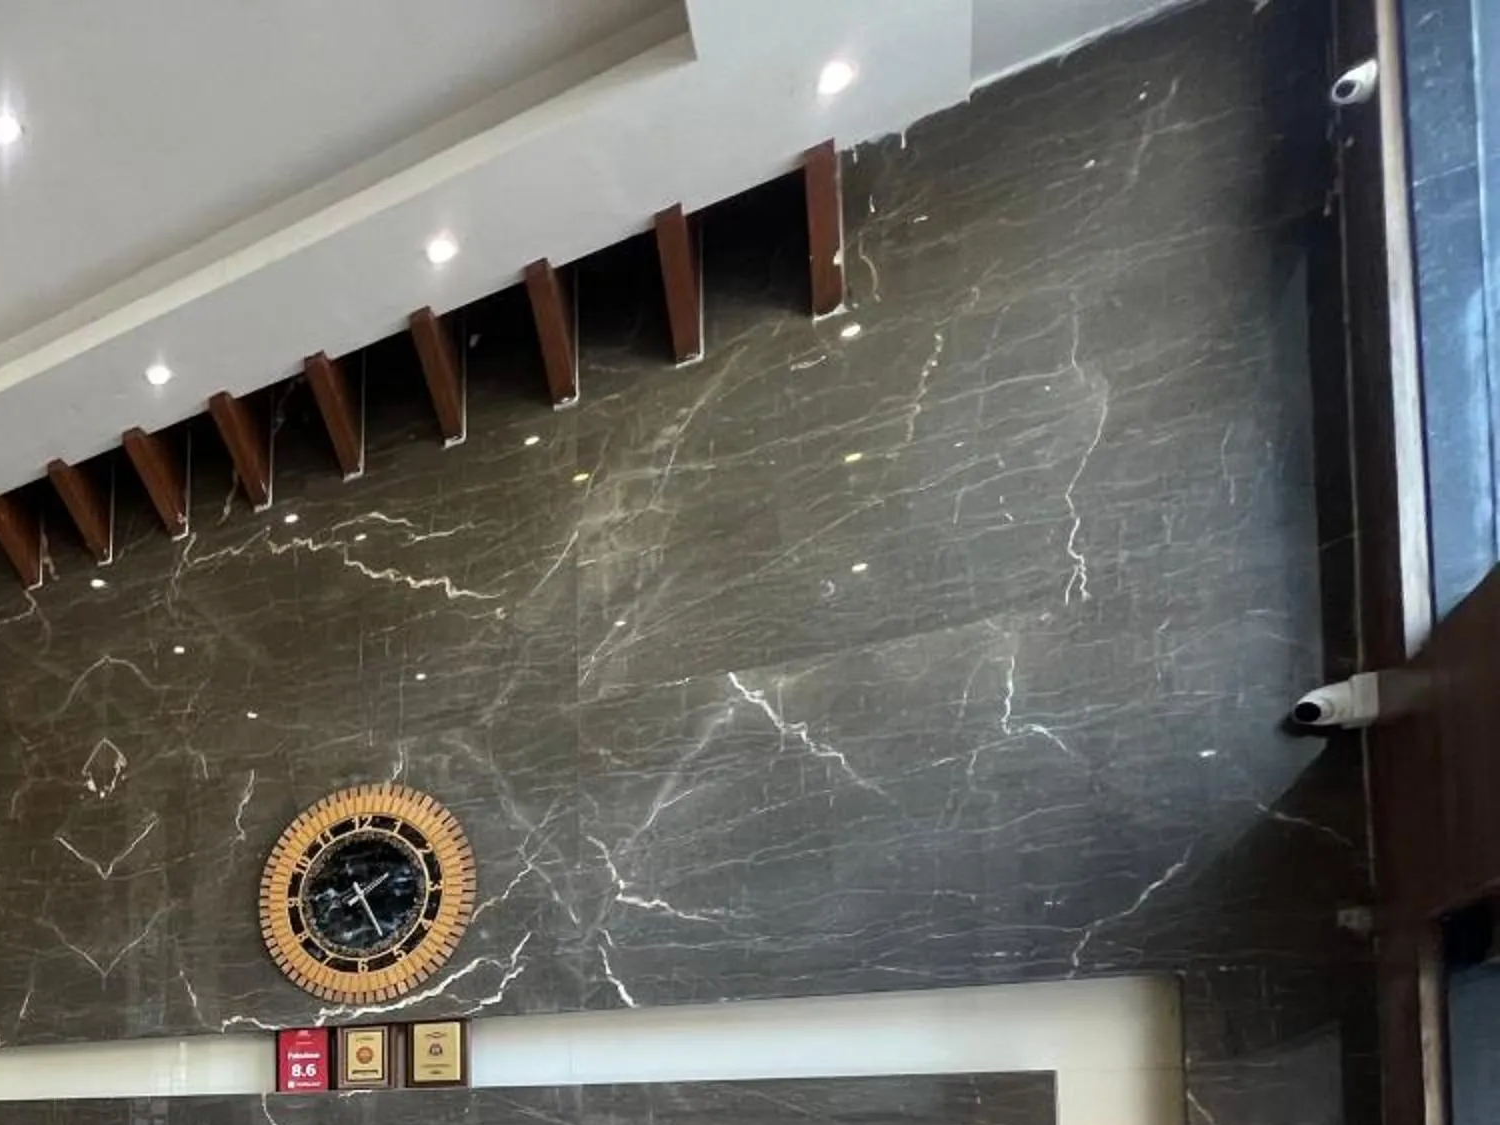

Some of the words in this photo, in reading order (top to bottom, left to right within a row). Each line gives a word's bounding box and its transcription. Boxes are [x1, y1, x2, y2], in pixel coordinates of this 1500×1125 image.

[352, 815, 372, 831] 12
[393, 820, 402, 834] 1
[316, 828, 334, 847] 11
[294, 856, 312, 873] 10
[393, 947, 406, 961] 5
[358, 959, 369, 973] 6
[291, 1063, 317, 1077] 8.6
